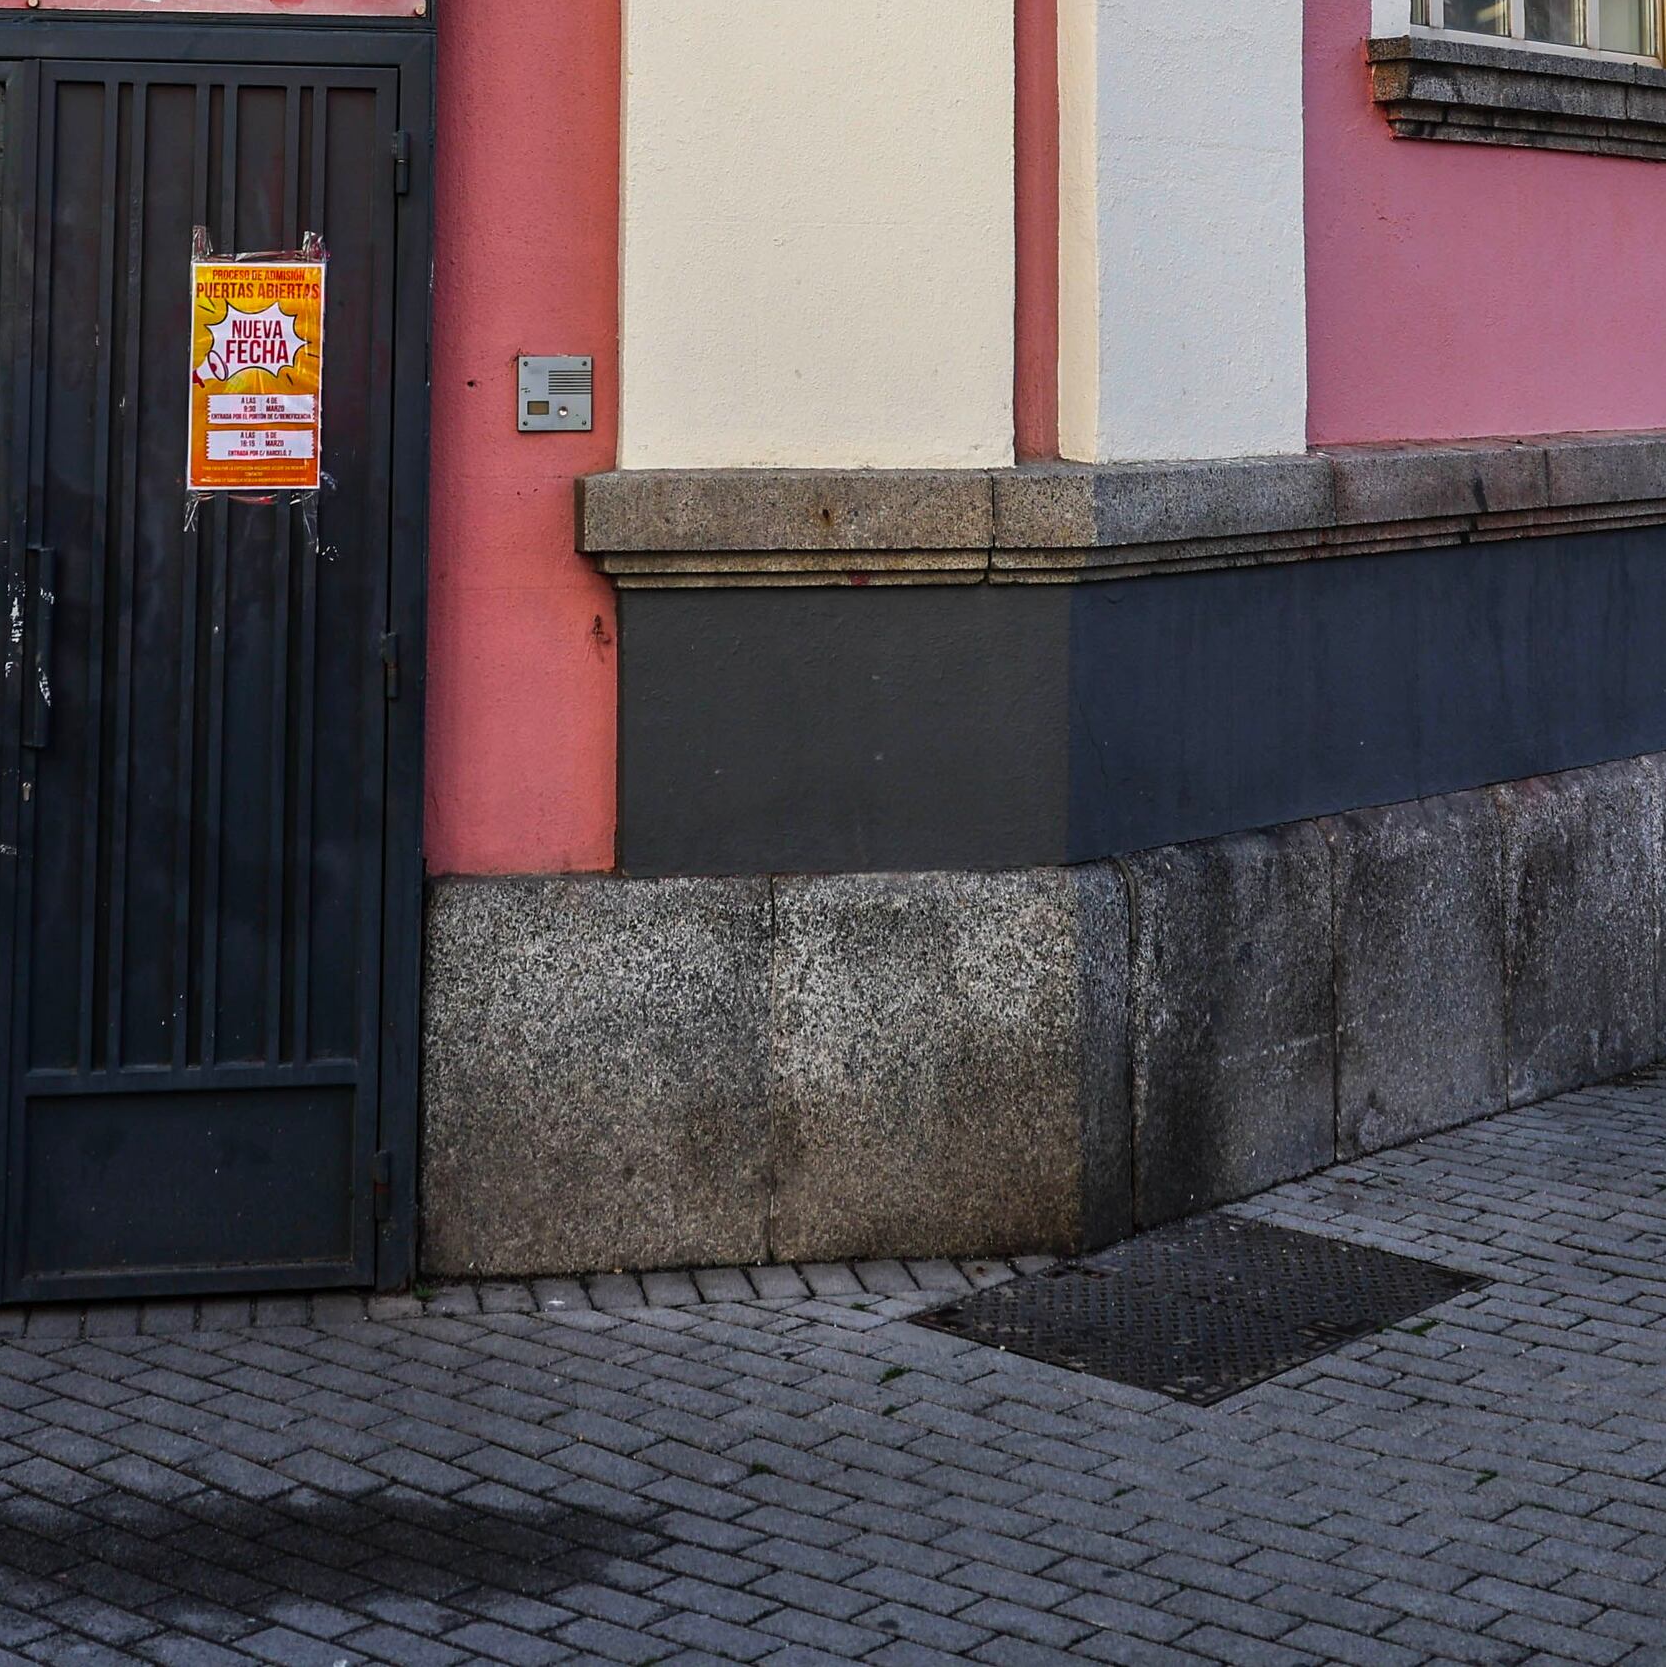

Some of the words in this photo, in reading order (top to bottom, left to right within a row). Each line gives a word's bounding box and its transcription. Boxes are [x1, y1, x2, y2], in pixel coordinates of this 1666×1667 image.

[213, 269, 250, 280] PROCESO
[251, 269, 262, 280] DE
[264, 269, 305, 281] ADMISIÓN
[196, 282, 254, 299] PUERTAS
[257, 283, 320, 299] ABIERTAS
[232, 320, 283, 339] NUEVA
[225, 340, 289, 364] FECHA
